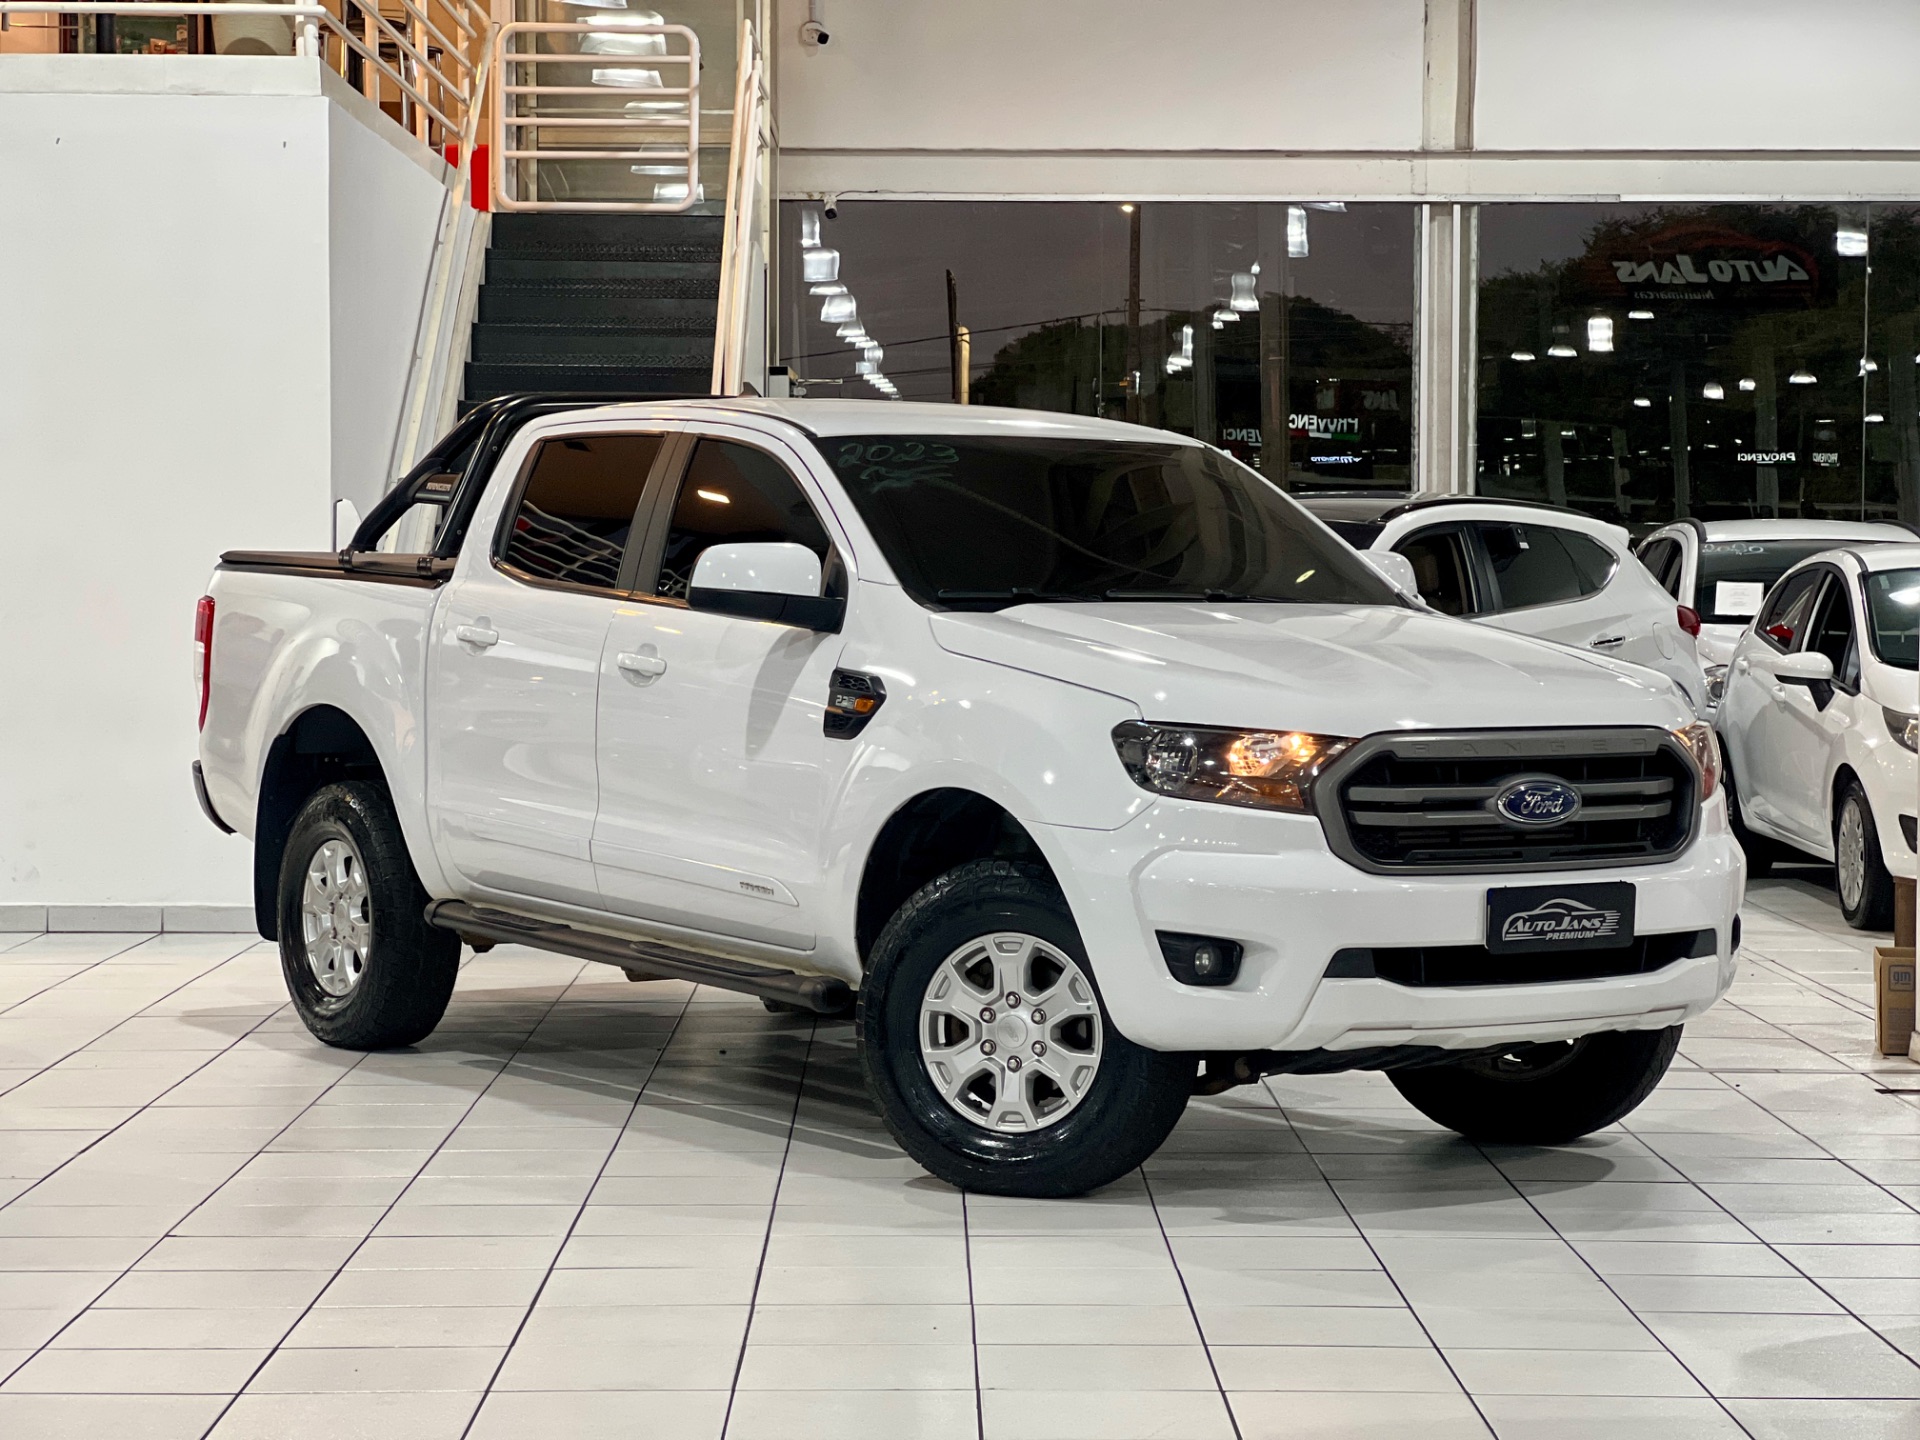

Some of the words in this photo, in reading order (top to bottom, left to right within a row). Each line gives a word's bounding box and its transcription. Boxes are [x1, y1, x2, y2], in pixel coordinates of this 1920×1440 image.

[838, 442, 960, 467] 2023
[1521, 789, 1564, 814] Ford
[1508, 918, 1556, 933] AUTO
[1555, 916, 1603, 931] JANS
[1545, 930, 1595, 940] PREMIUM
